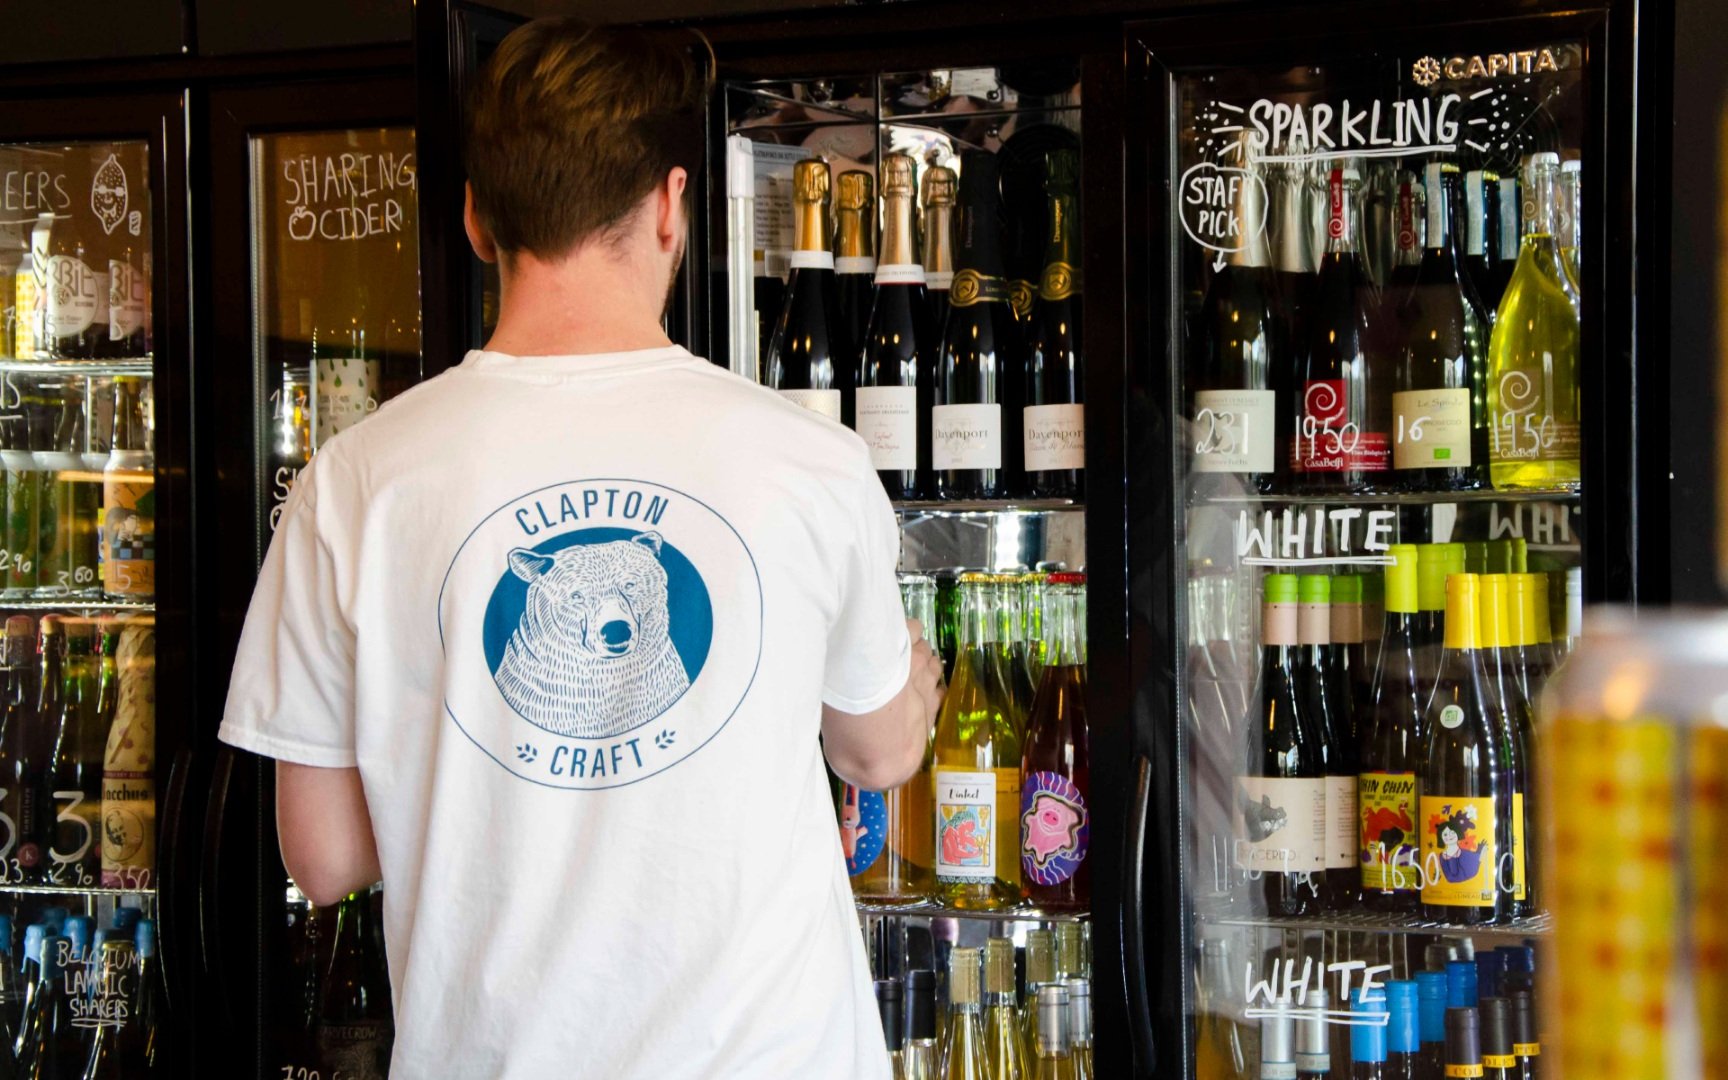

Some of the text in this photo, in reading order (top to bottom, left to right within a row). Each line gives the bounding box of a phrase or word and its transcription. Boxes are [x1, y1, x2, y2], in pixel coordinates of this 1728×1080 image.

[1444, 49, 1558, 80] CAPITA
[1249, 94, 1460, 148] SPARKLING
[0, 171, 71, 211] EERS
[283, 153, 416, 204] SHARING
[320, 200, 402, 240] CIDER
[1198, 210, 1240, 238] PICK
[1397, 415, 1431, 444] 16
[515, 488, 669, 536] CLAPTON
[1489, 503, 1580, 545] WHI
[1238, 508, 1396, 559] WHITE
[550, 738, 643, 778] CRAFT
[1383, 780, 1414, 794] CHIN
[1244, 956, 1393, 1006] WHITE
